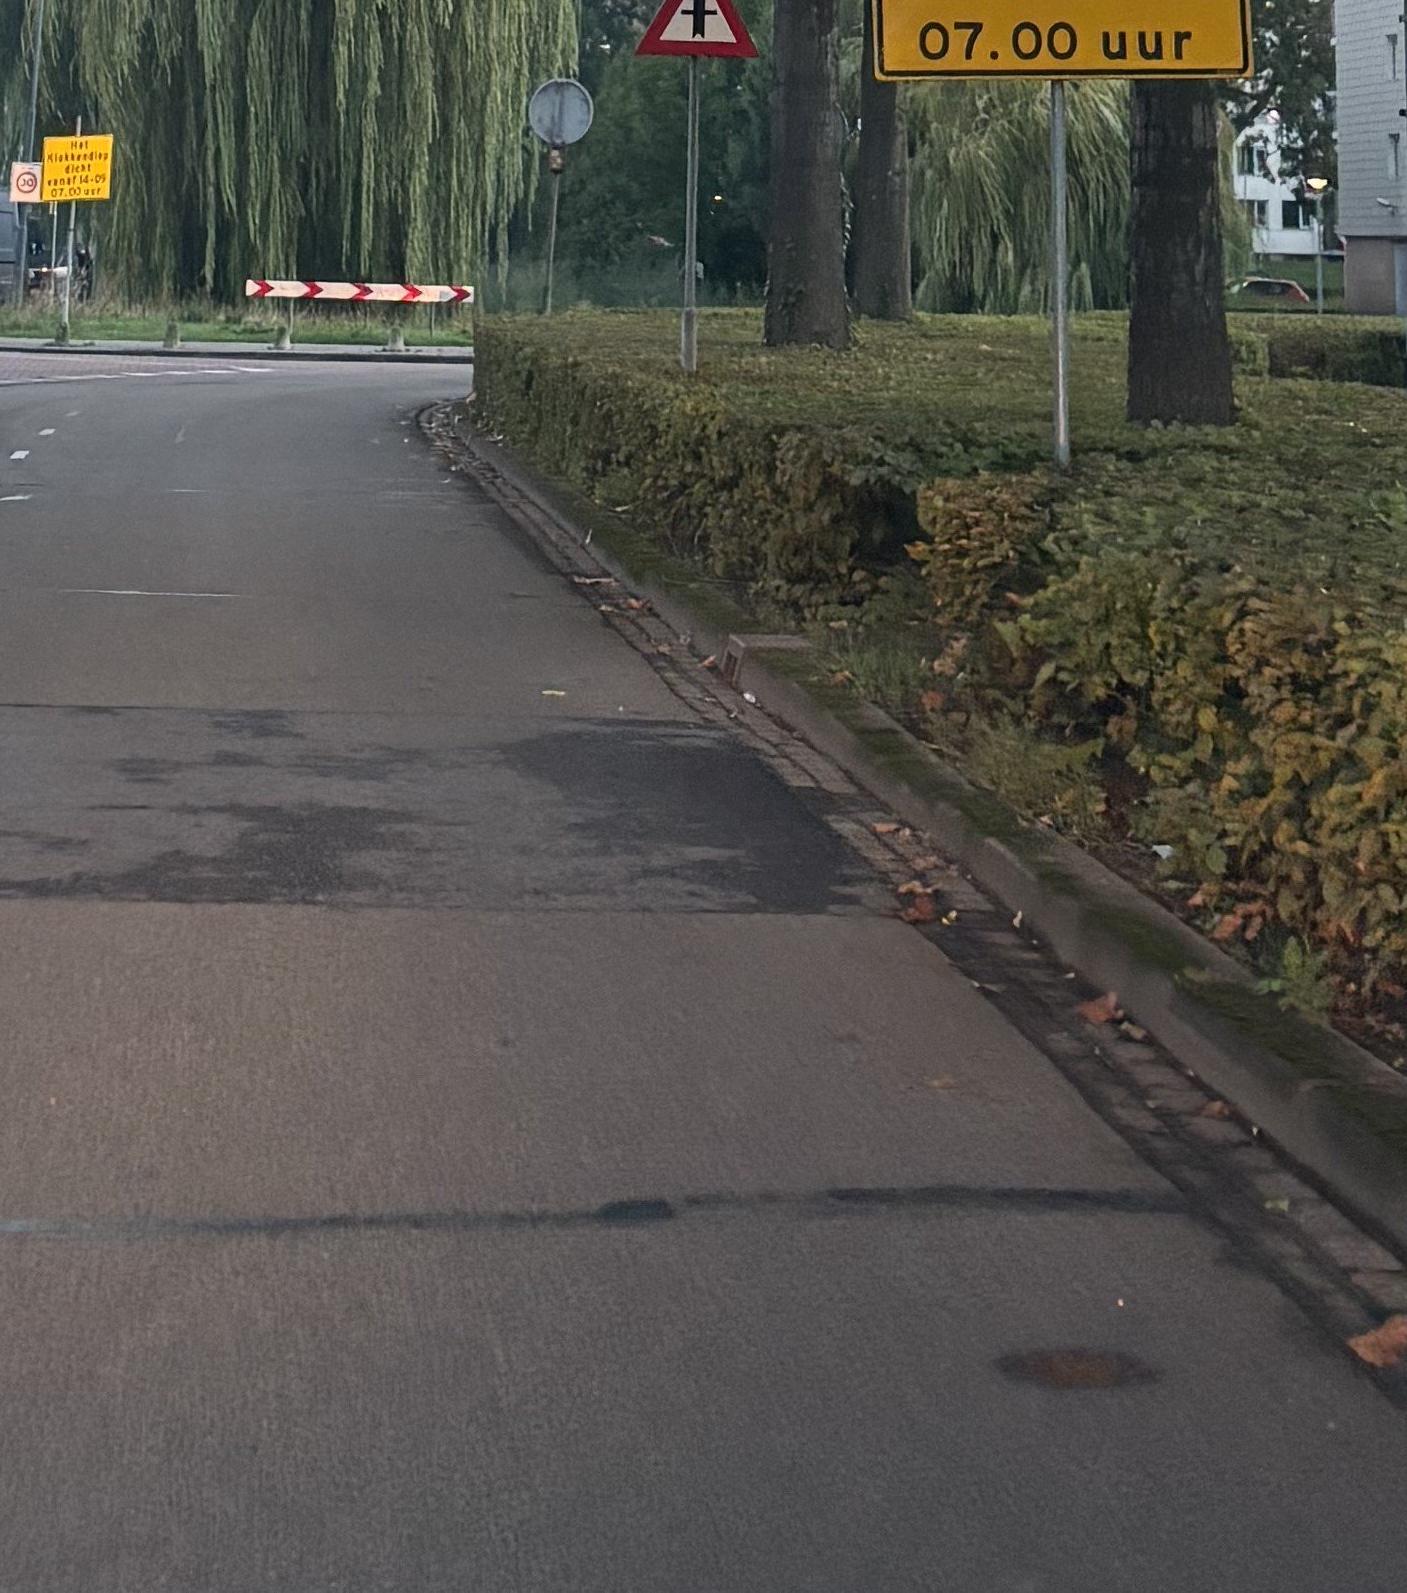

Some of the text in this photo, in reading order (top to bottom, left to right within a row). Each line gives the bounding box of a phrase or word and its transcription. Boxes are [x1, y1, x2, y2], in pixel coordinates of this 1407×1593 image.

[919, 21, 1193, 61] 07.00 uur
[70, 140, 89, 150] Het
[64, 164, 91, 174] dicht
[47, 175, 76, 187] vanaf
[84, 187, 101, 196] uur
